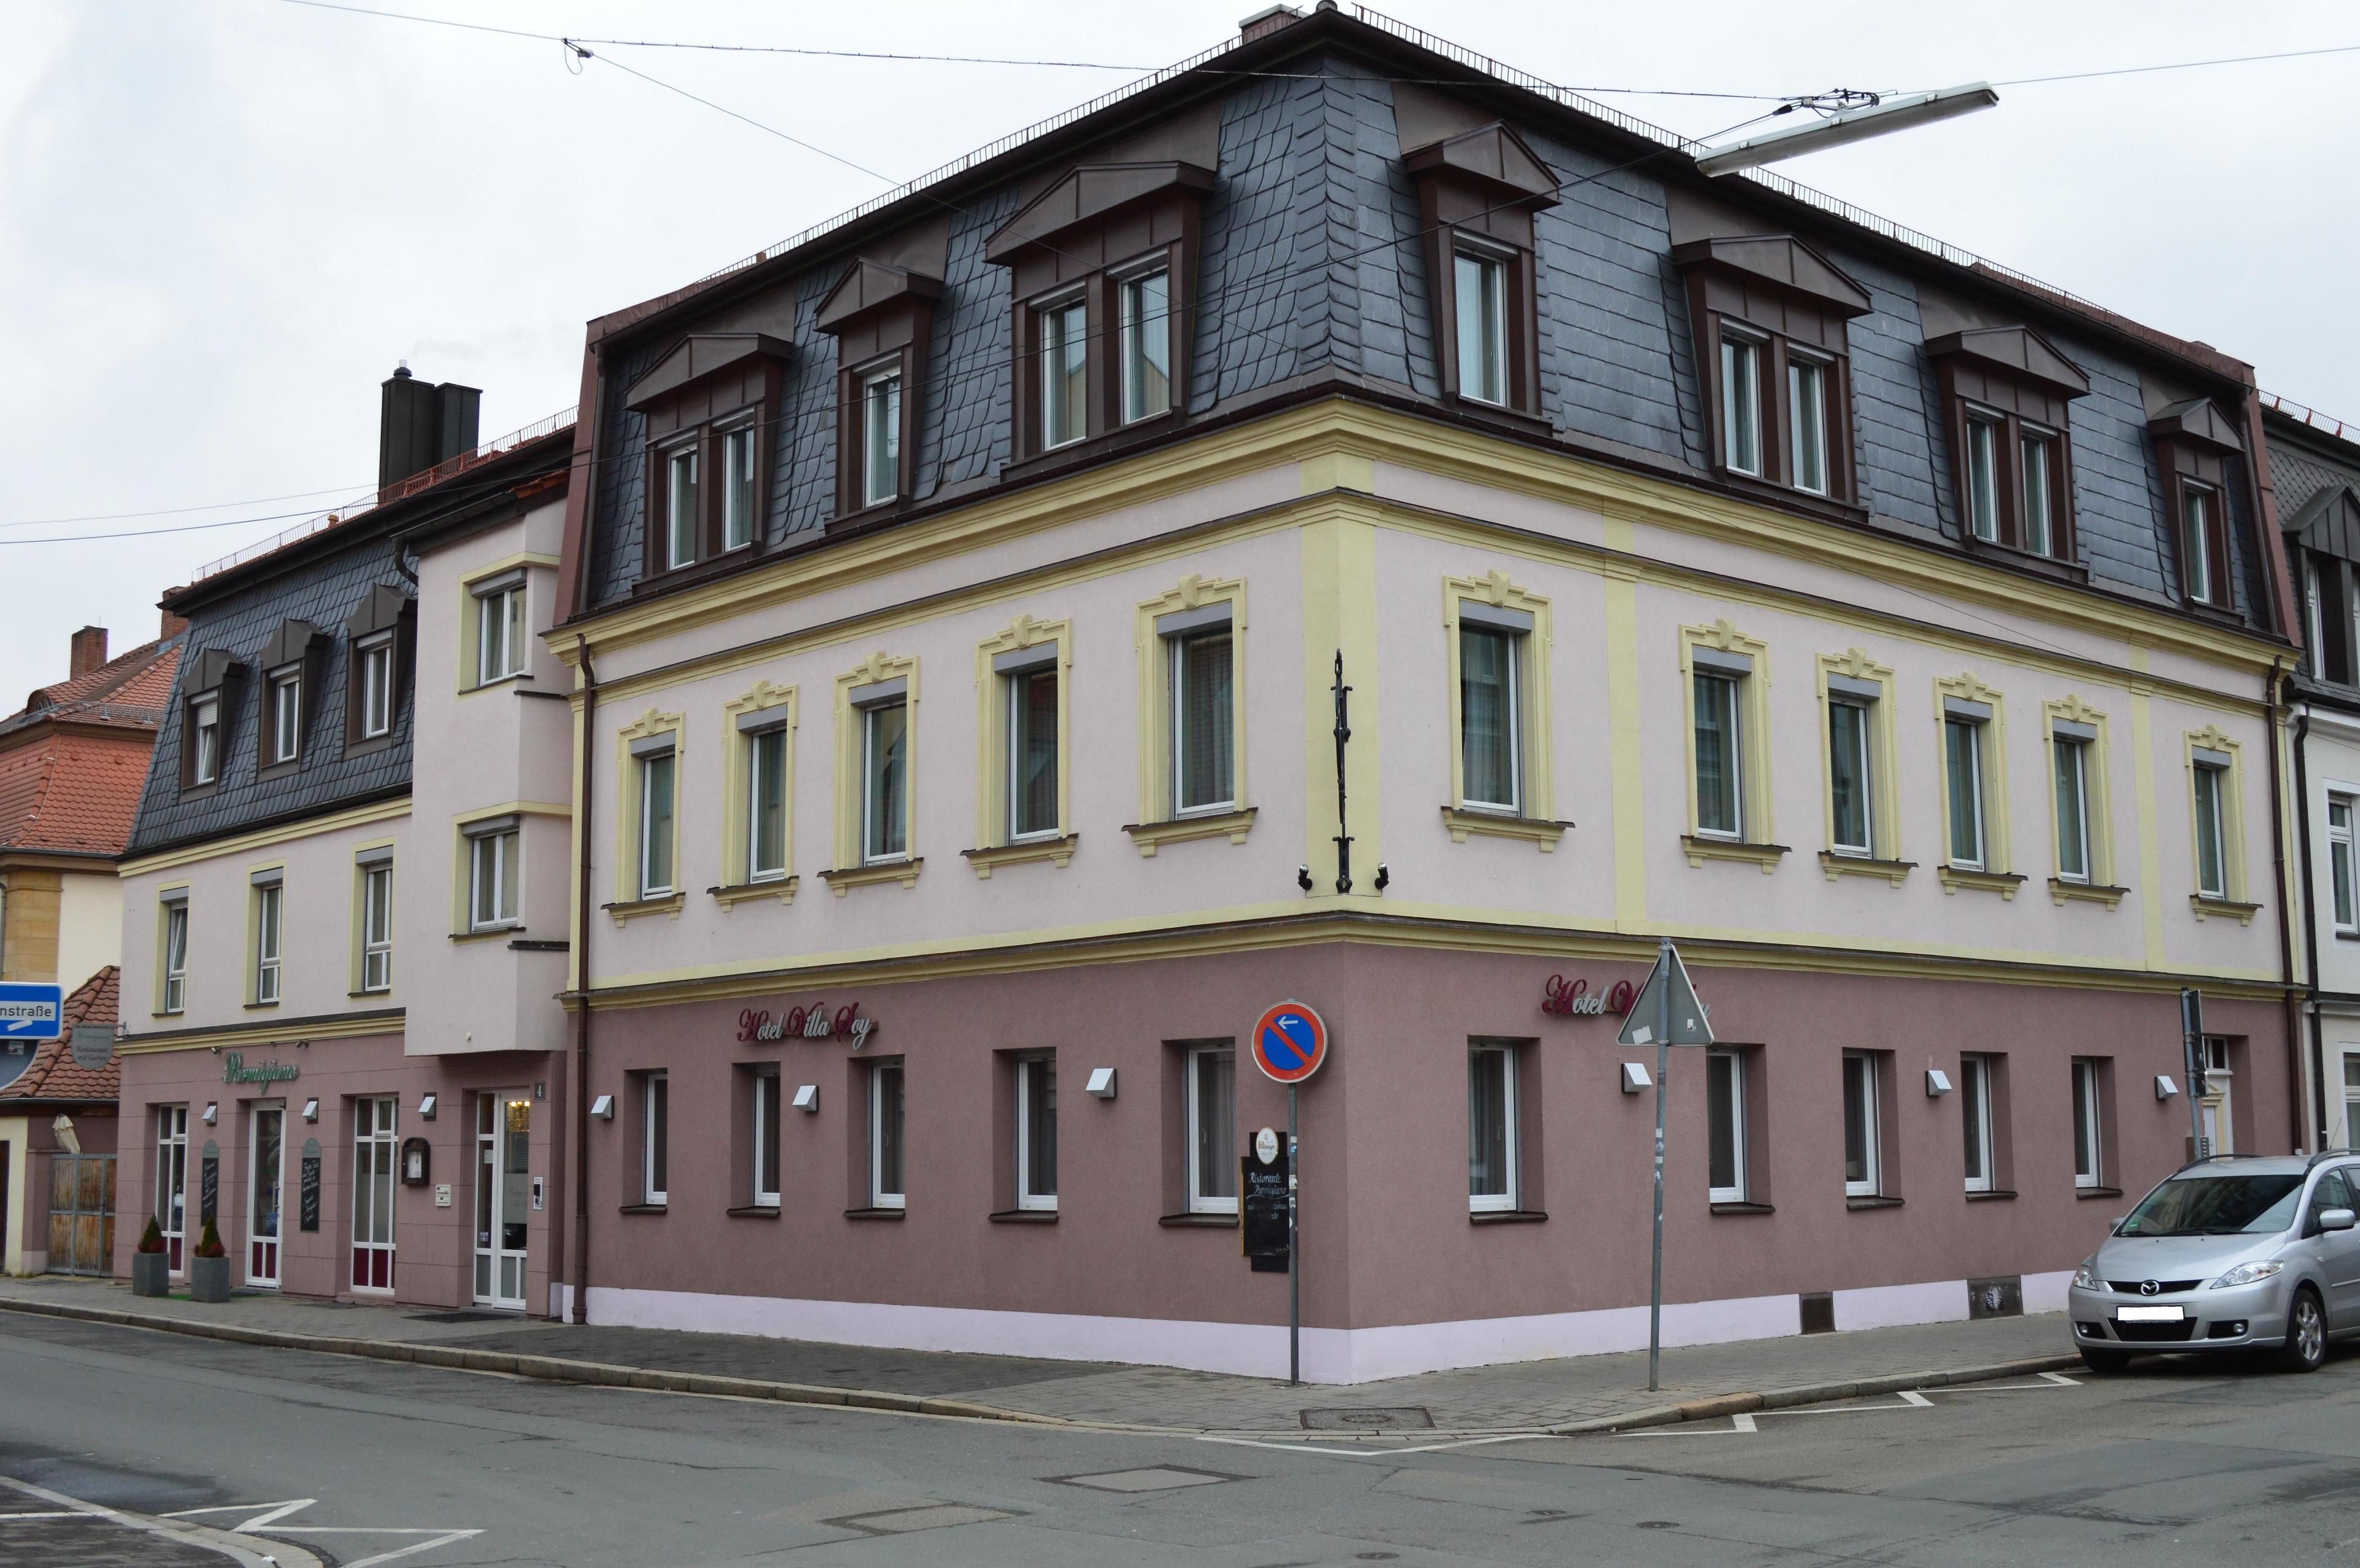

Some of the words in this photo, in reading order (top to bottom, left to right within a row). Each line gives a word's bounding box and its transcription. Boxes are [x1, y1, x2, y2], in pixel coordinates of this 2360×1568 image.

[1542, 974, 1610, 1014] Hotel
[738, 1008, 786, 1041] Hotel
[787, 1002, 830, 1040] Villa
[537, 1084, 542, 1097] 4
[1249, 1172, 1282, 1183] Ristorante
